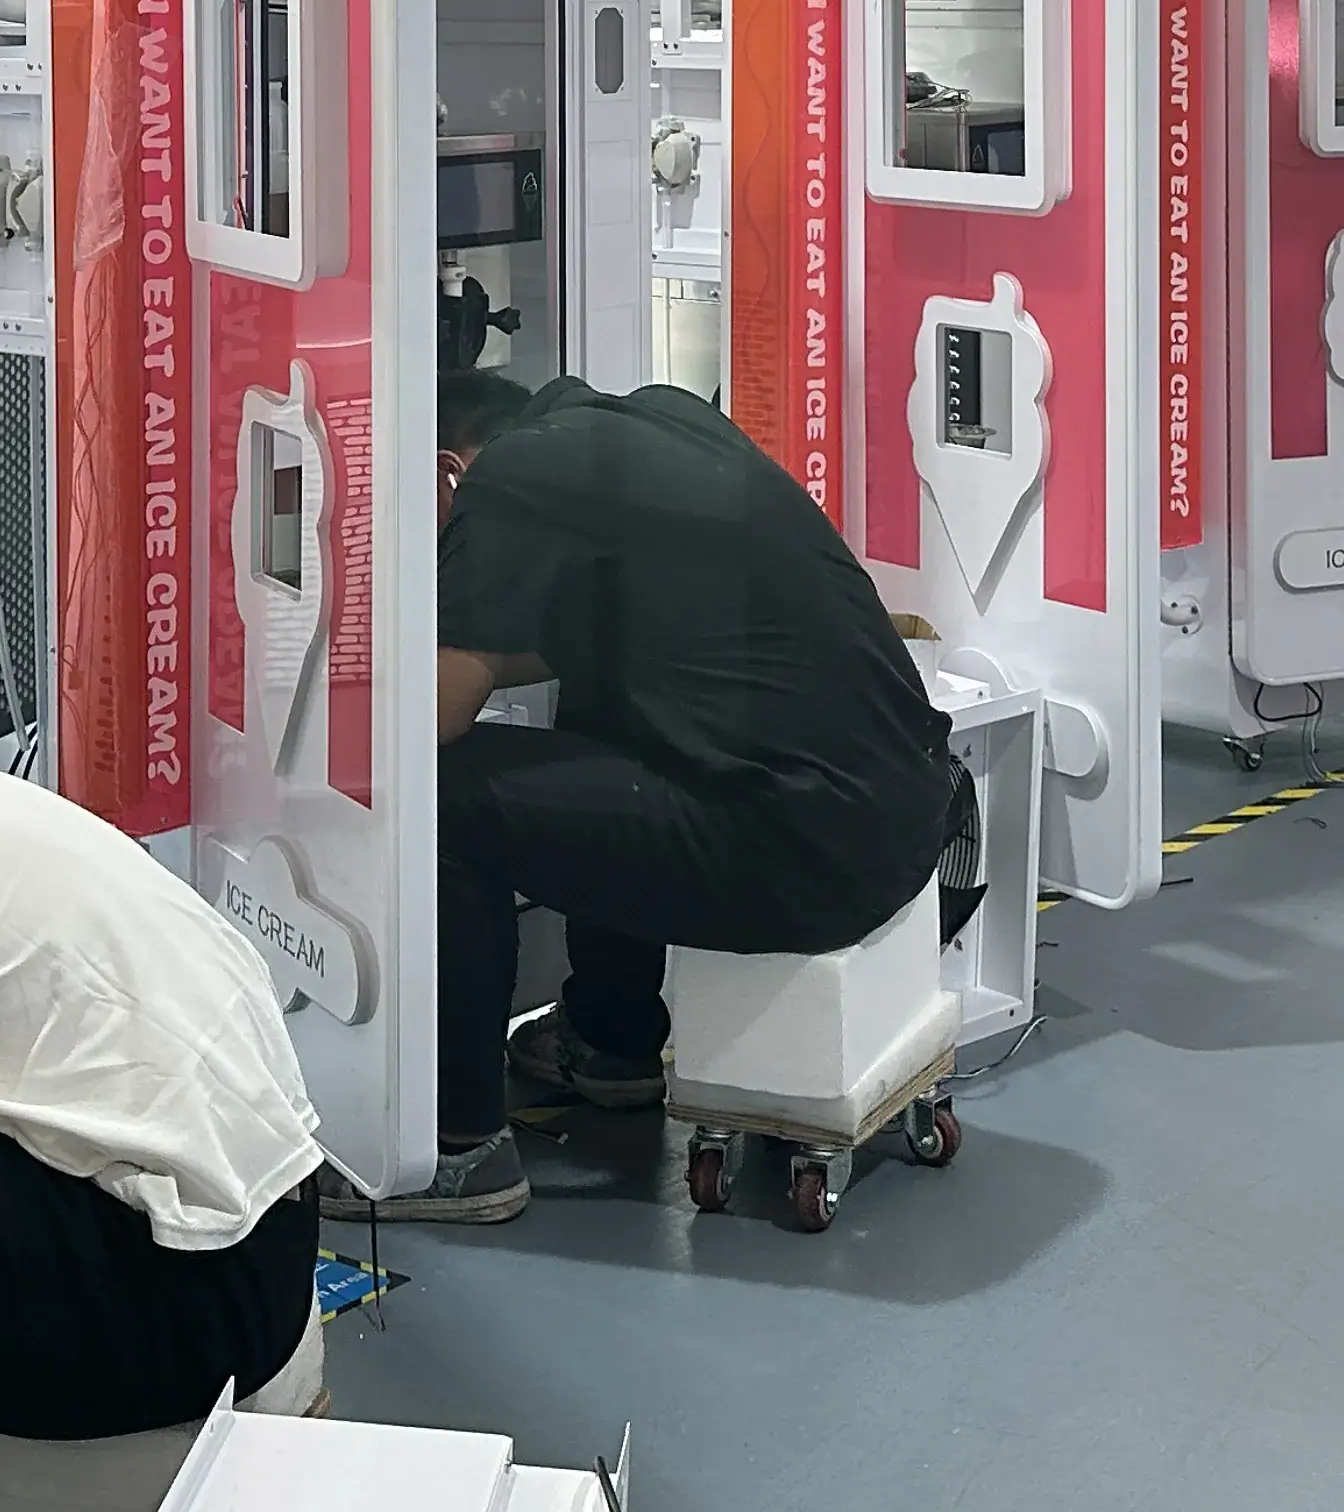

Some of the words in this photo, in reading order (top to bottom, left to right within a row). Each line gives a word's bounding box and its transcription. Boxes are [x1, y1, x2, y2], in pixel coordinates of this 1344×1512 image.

[807, 20, 826, 143] WANT
[1170, 7, 1188, 112] WANT
[139, 28, 172, 182] WANT
[806, 152, 826, 208] TO
[1170, 119, 1188, 167] TO
[141, 195, 173, 265] TO
[1170, 175, 1189, 244] EAT
[806, 217, 826, 299] EAT
[1170, 252, 1189, 302] AN
[143, 276, 175, 378] EAT
[806, 308, 826, 367] AN
[1170, 311, 1189, 365] ICE
[144, 392, 176, 466] AN
[806, 378, 827, 441] ICE
[1170, 373, 1190, 517] CREAM?
[145, 477, 177, 559] ICE
[146, 572, 181, 785] CREAM?
[225, 878, 254, 928] ICE
[257, 902, 325, 979] CREAM
[327, 1271, 369, 1292] Area
